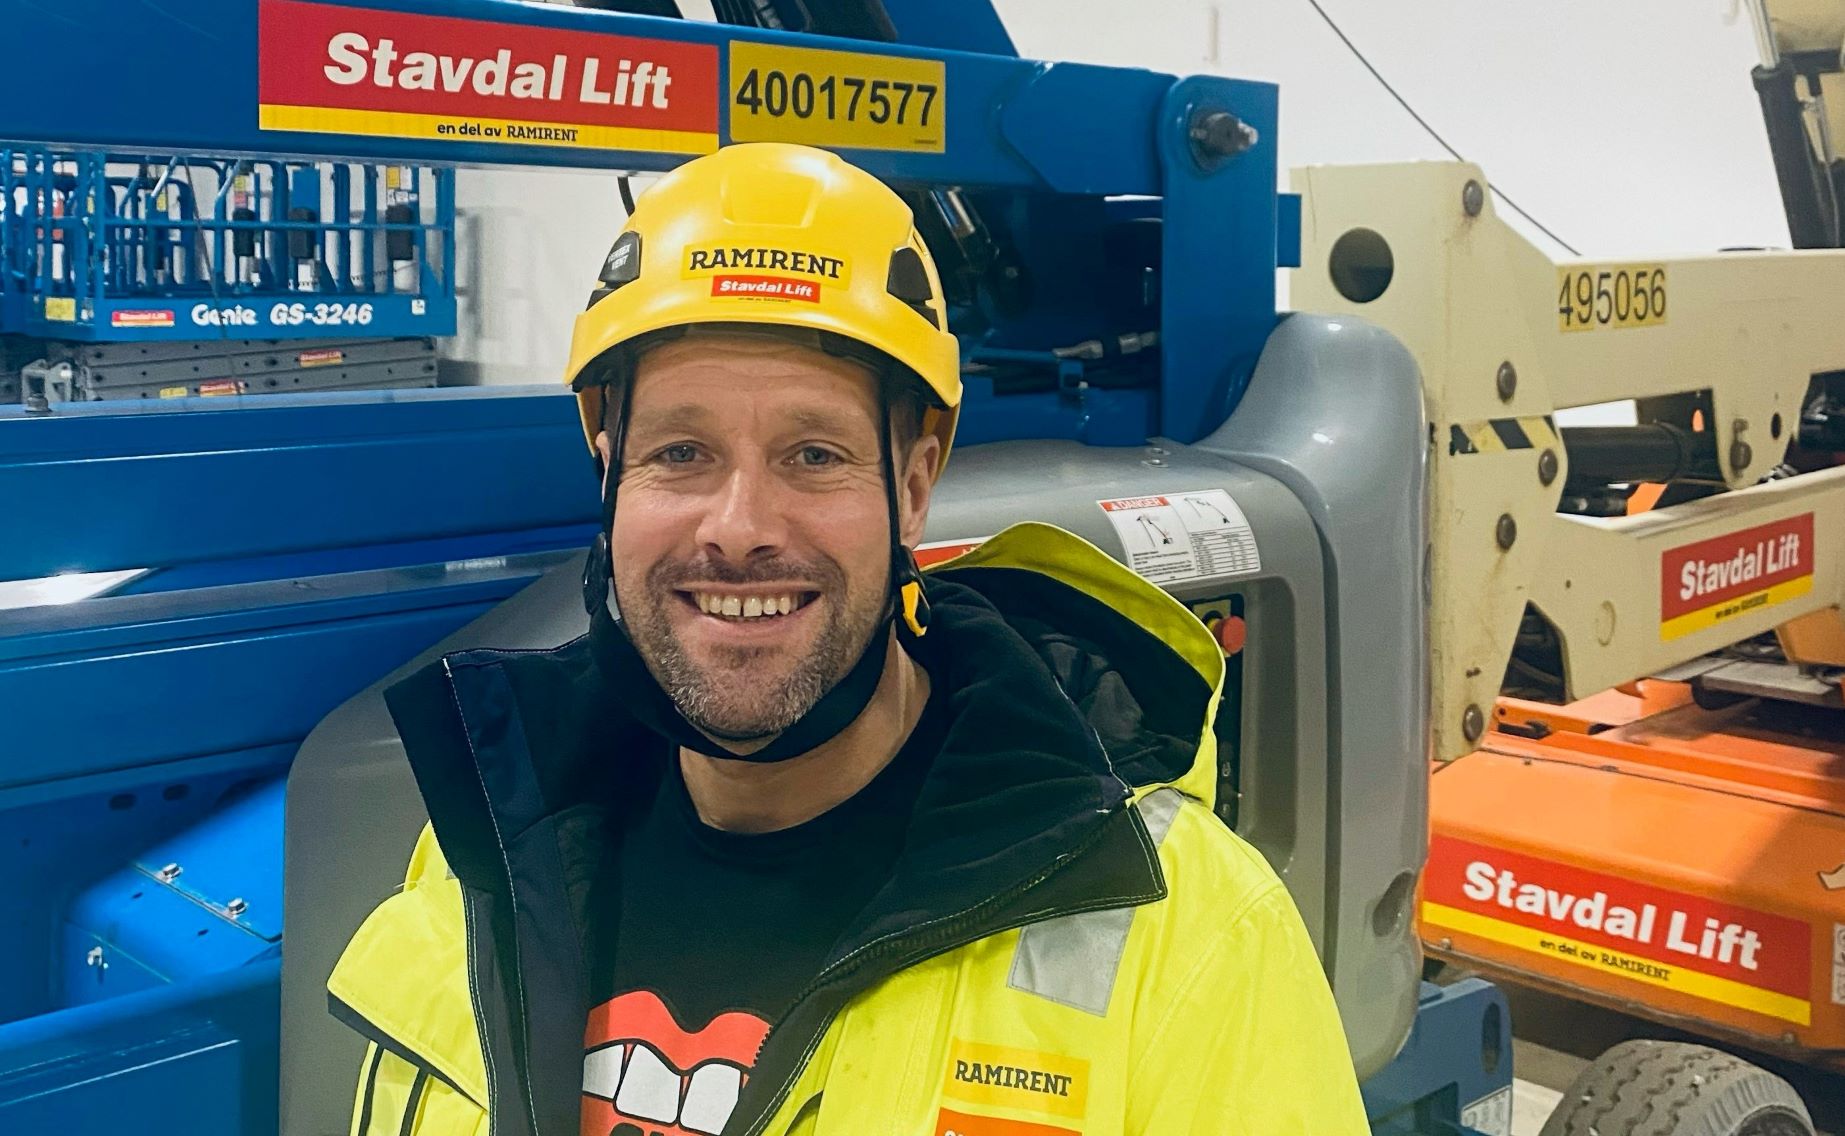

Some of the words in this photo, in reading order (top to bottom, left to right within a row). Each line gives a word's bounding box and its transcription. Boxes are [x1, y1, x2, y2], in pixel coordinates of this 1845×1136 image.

[323, 31, 568, 100] Stavdal
[579, 57, 672, 109] Lift
[736, 68, 938, 127] 40017577
[437, 124, 456, 135] en
[459, 122, 481, 136] del
[484, 126, 501, 137] av
[507, 125, 578, 142] RAMIRENT
[689, 248, 844, 279] RAMIRENT
[719, 280, 782, 294] Stavdal
[784, 283, 813, 297] Lift
[1558, 268, 1666, 326] 495056
[191, 303, 259, 326] Genie
[270, 303, 373, 326] GS-3246
[1680, 541, 1764, 601] Stavdal
[1766, 533, 1800, 574] Lift
[1462, 861, 1657, 943] Stavdal
[1665, 910, 1762, 971] Lift
[1601, 952, 1671, 982] RAMIRENT
[955, 1059, 1072, 1097] RAMIRENT
